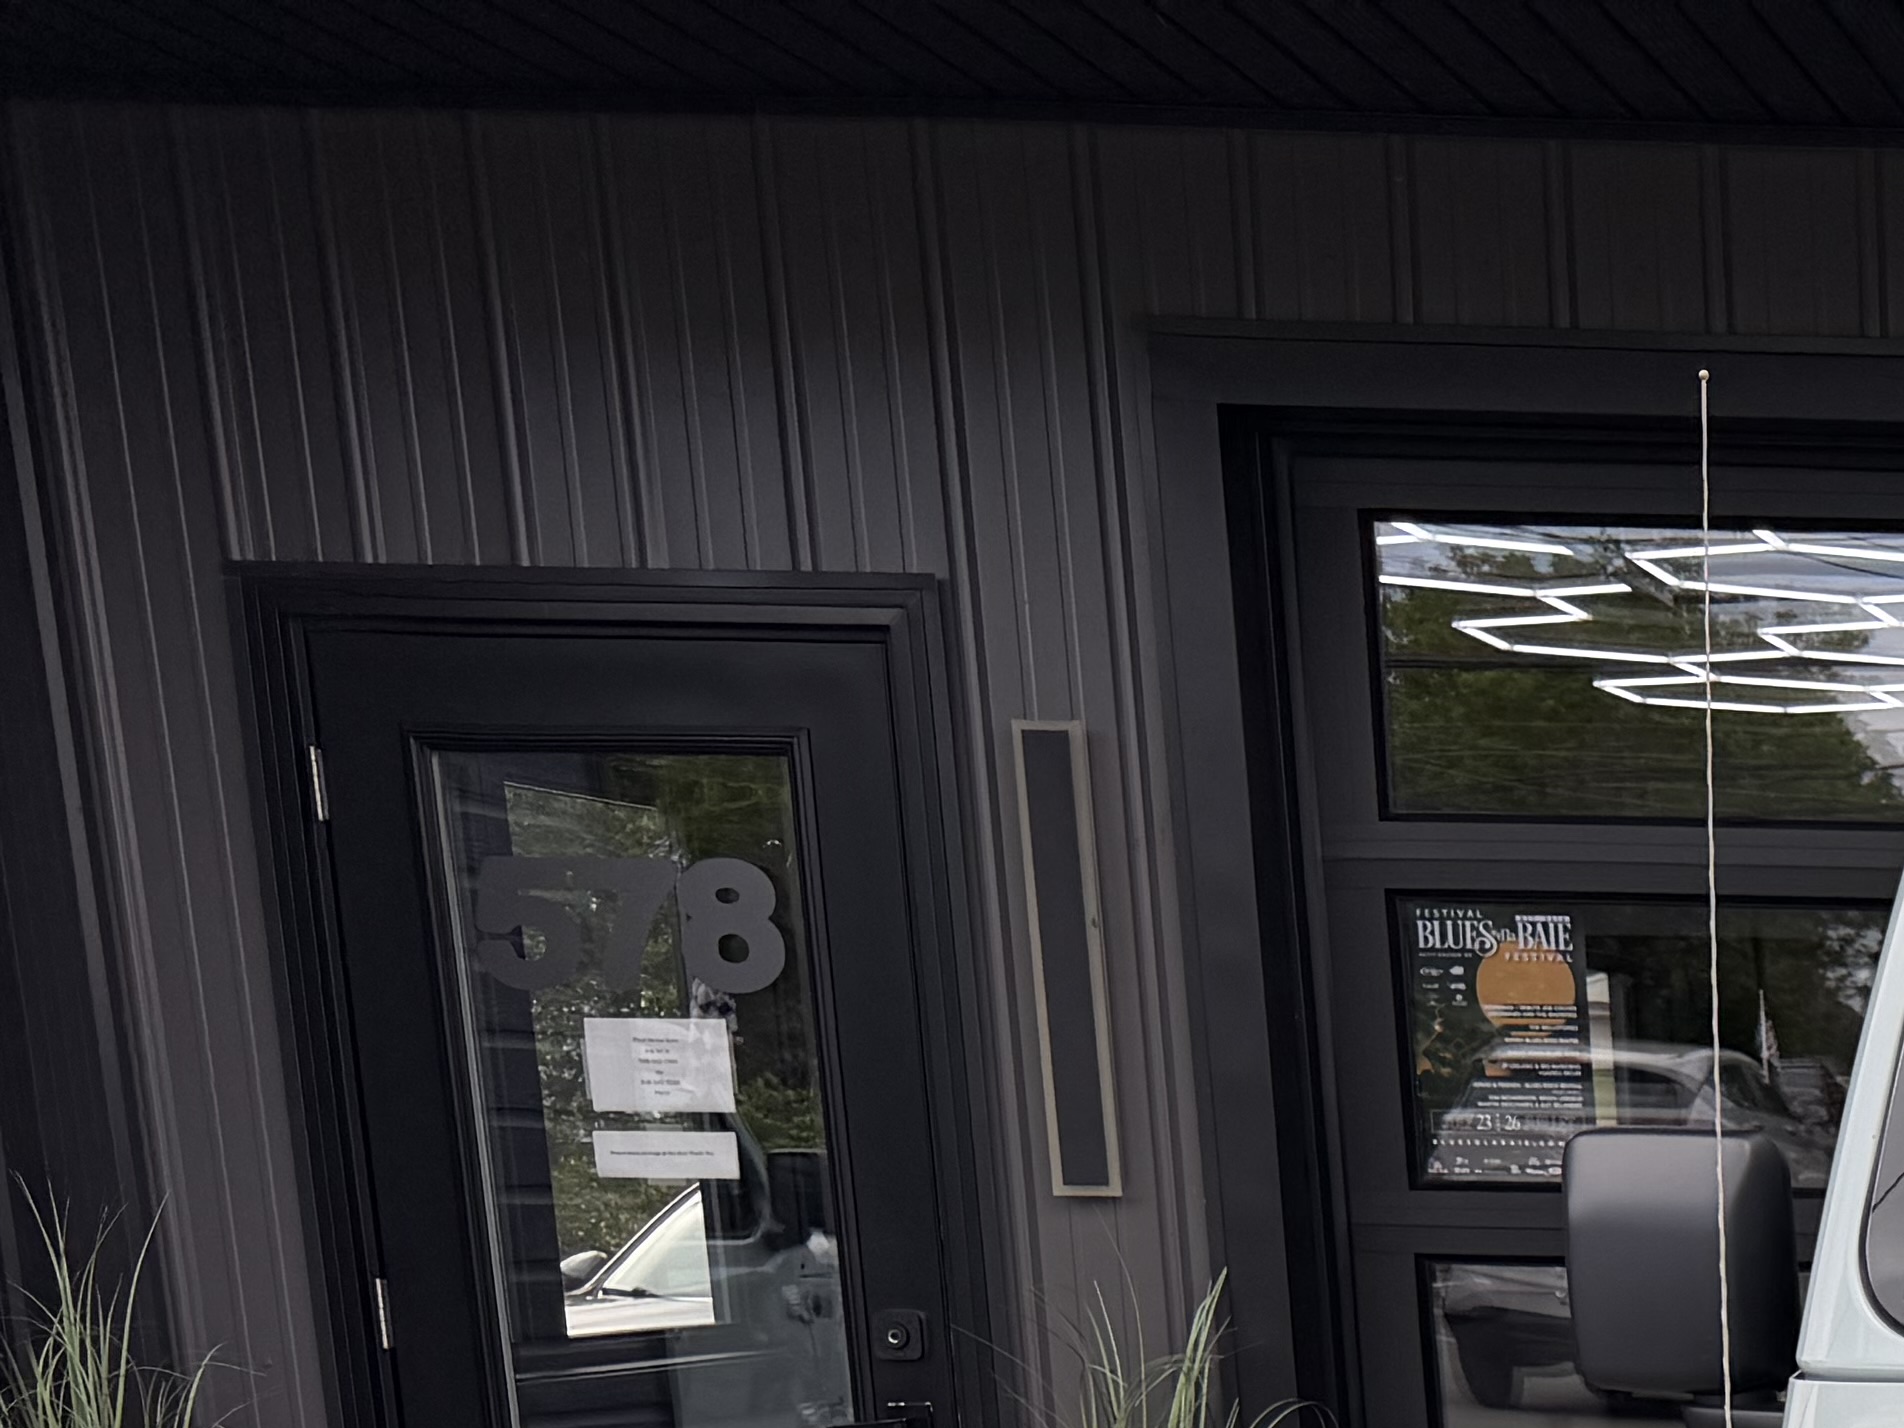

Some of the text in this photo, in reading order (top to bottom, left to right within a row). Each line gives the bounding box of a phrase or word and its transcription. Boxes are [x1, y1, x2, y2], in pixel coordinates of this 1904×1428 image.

[1415, 908, 1483, 919] FESTIVAL
[475, 856, 786, 994] 578
[1415, 919, 1498, 959] BLUES
[1517, 921, 1574, 951] BAIE
[1505, 952, 1573, 963] FESTIVAL
[1476, 1114, 1492, 1131] 23
[1505, 1114, 1521, 1131] 26
